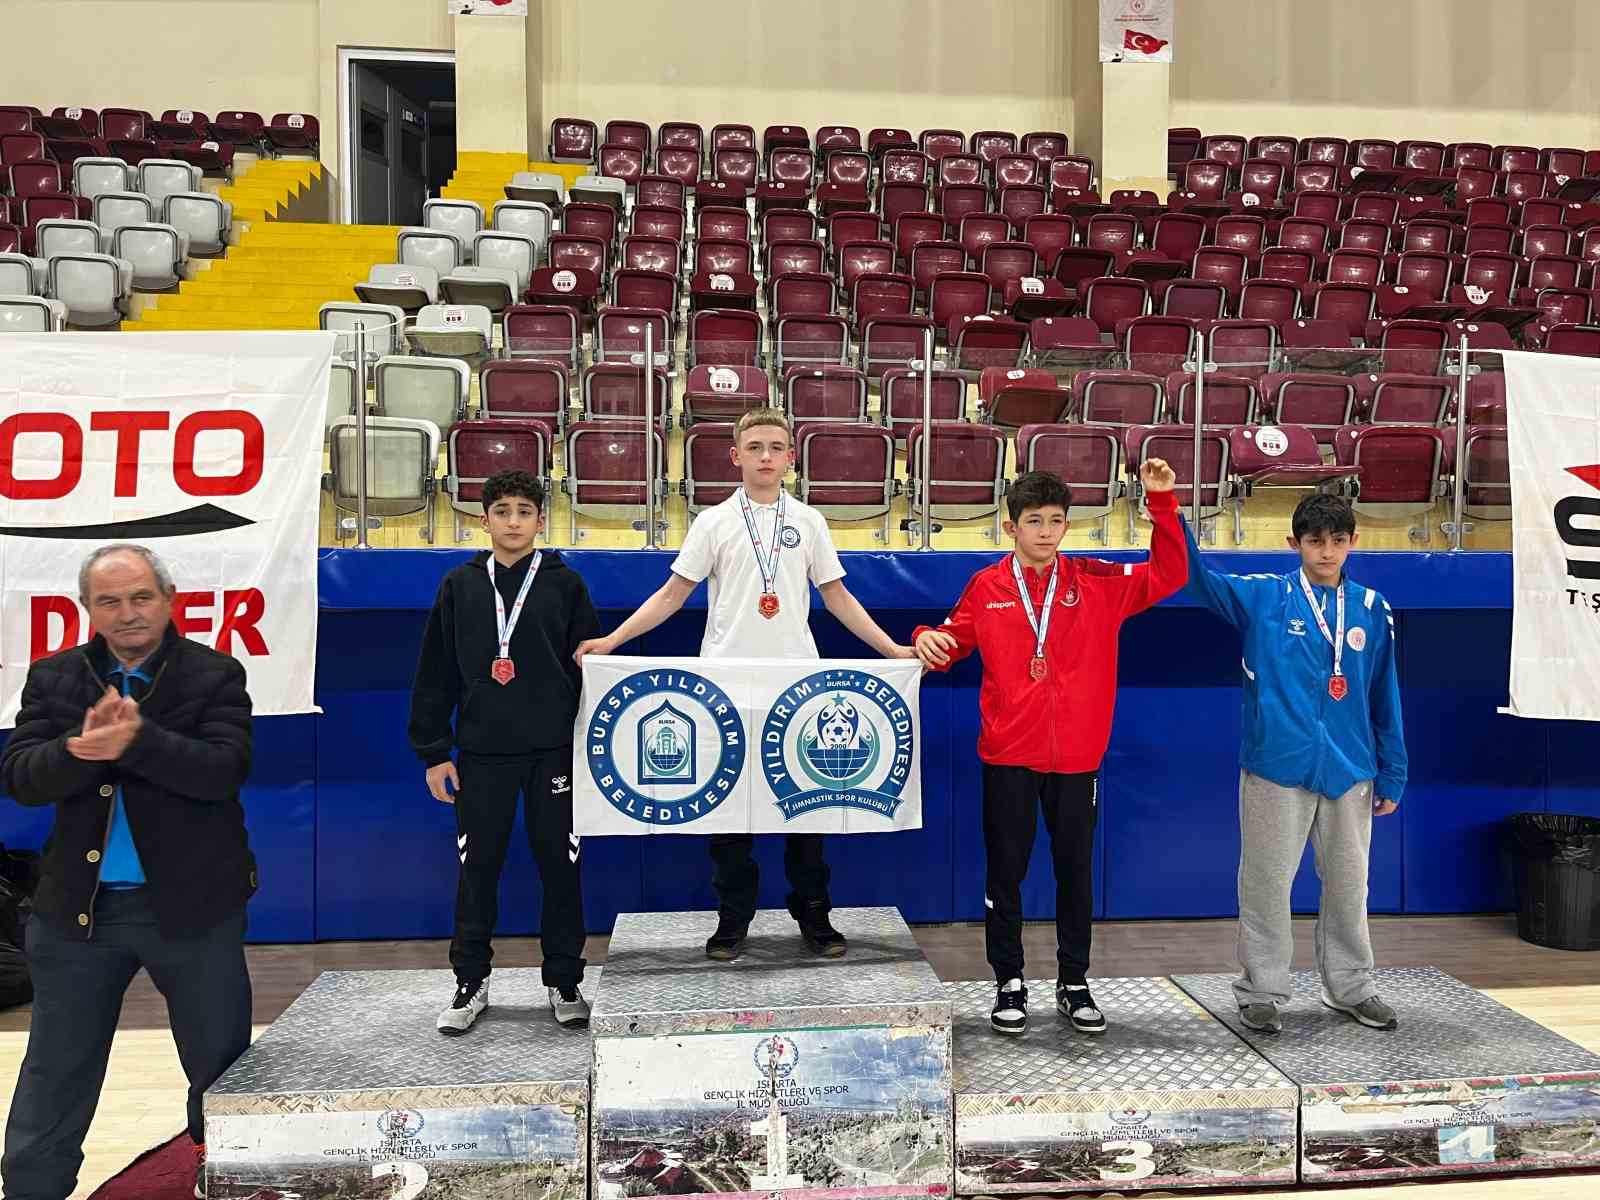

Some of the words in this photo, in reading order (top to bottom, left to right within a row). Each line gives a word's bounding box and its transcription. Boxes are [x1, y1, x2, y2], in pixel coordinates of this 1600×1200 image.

[986, 600, 1016, 609] uhlsport
[592, 685, 635, 755] BURSA
[648, 674, 739, 745] YILDIRIM
[766, 681, 813, 785] YILDIRIM
[600, 766, 737, 820] BELEDİYESİ
[835, 793, 856, 801] SPOR
[808, 1086, 822, 1096] VE
[823, 1085, 849, 1095] SPOR
[434, 1143, 449, 1151] VE
[450, 1142, 478, 1151] SPOR
[750, 1113, 804, 1191] 1
[1100, 1140, 1156, 1180] 3
